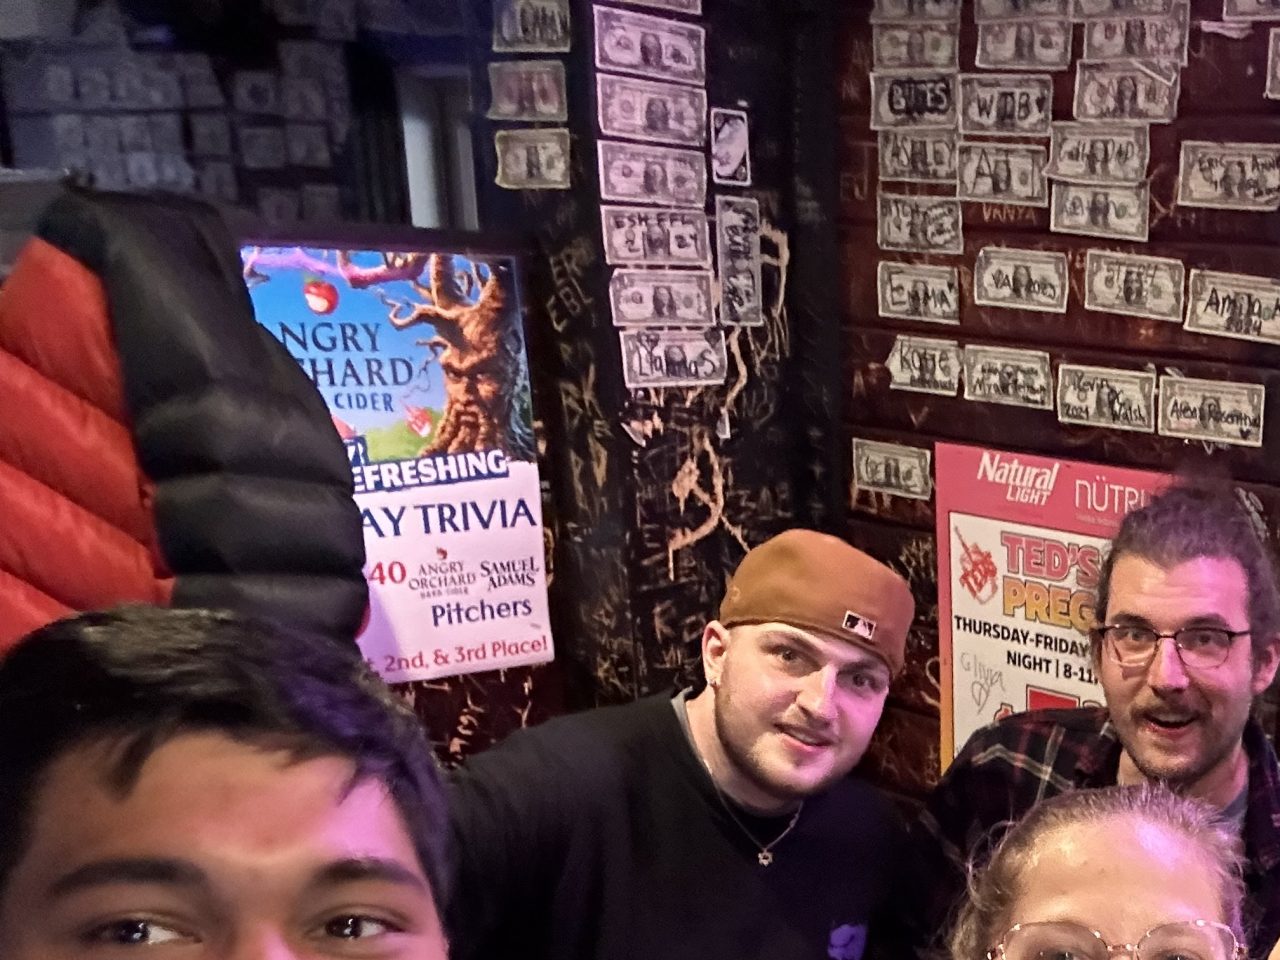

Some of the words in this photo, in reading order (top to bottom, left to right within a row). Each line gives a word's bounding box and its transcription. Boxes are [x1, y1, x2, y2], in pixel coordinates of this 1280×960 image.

[279, 321, 382, 352] NGRY
[301, 357, 414, 387] HARD
[334, 392, 395, 412] CIDER
[352, 449, 508, 492] EFRESHING
[977, 452, 1060, 492] Natural
[1006, 485, 1052, 507] LIGHT
[363, 505, 407, 538] AY
[412, 498, 537, 535] TRIVIA
[418, 560, 465, 576] ANGRY
[480, 556, 541, 577] SAMUEL
[1000, 529, 1100, 589] TED'S
[408, 572, 477, 591] ORCHARD
[487, 572, 537, 593] ADAMS
[431, 599, 533, 628] Pitchers
[1002, 575, 1096, 637] PREG
[384, 650, 430, 673] 2nd,
[455, 640, 488, 664] 3rd
[491, 634, 548, 659] Place!
[954, 614, 1090, 658] THURSDAY-FRIDAY
[1006, 650, 1052, 674] NIGHT
[1063, 662, 1098, 686] 8-11
